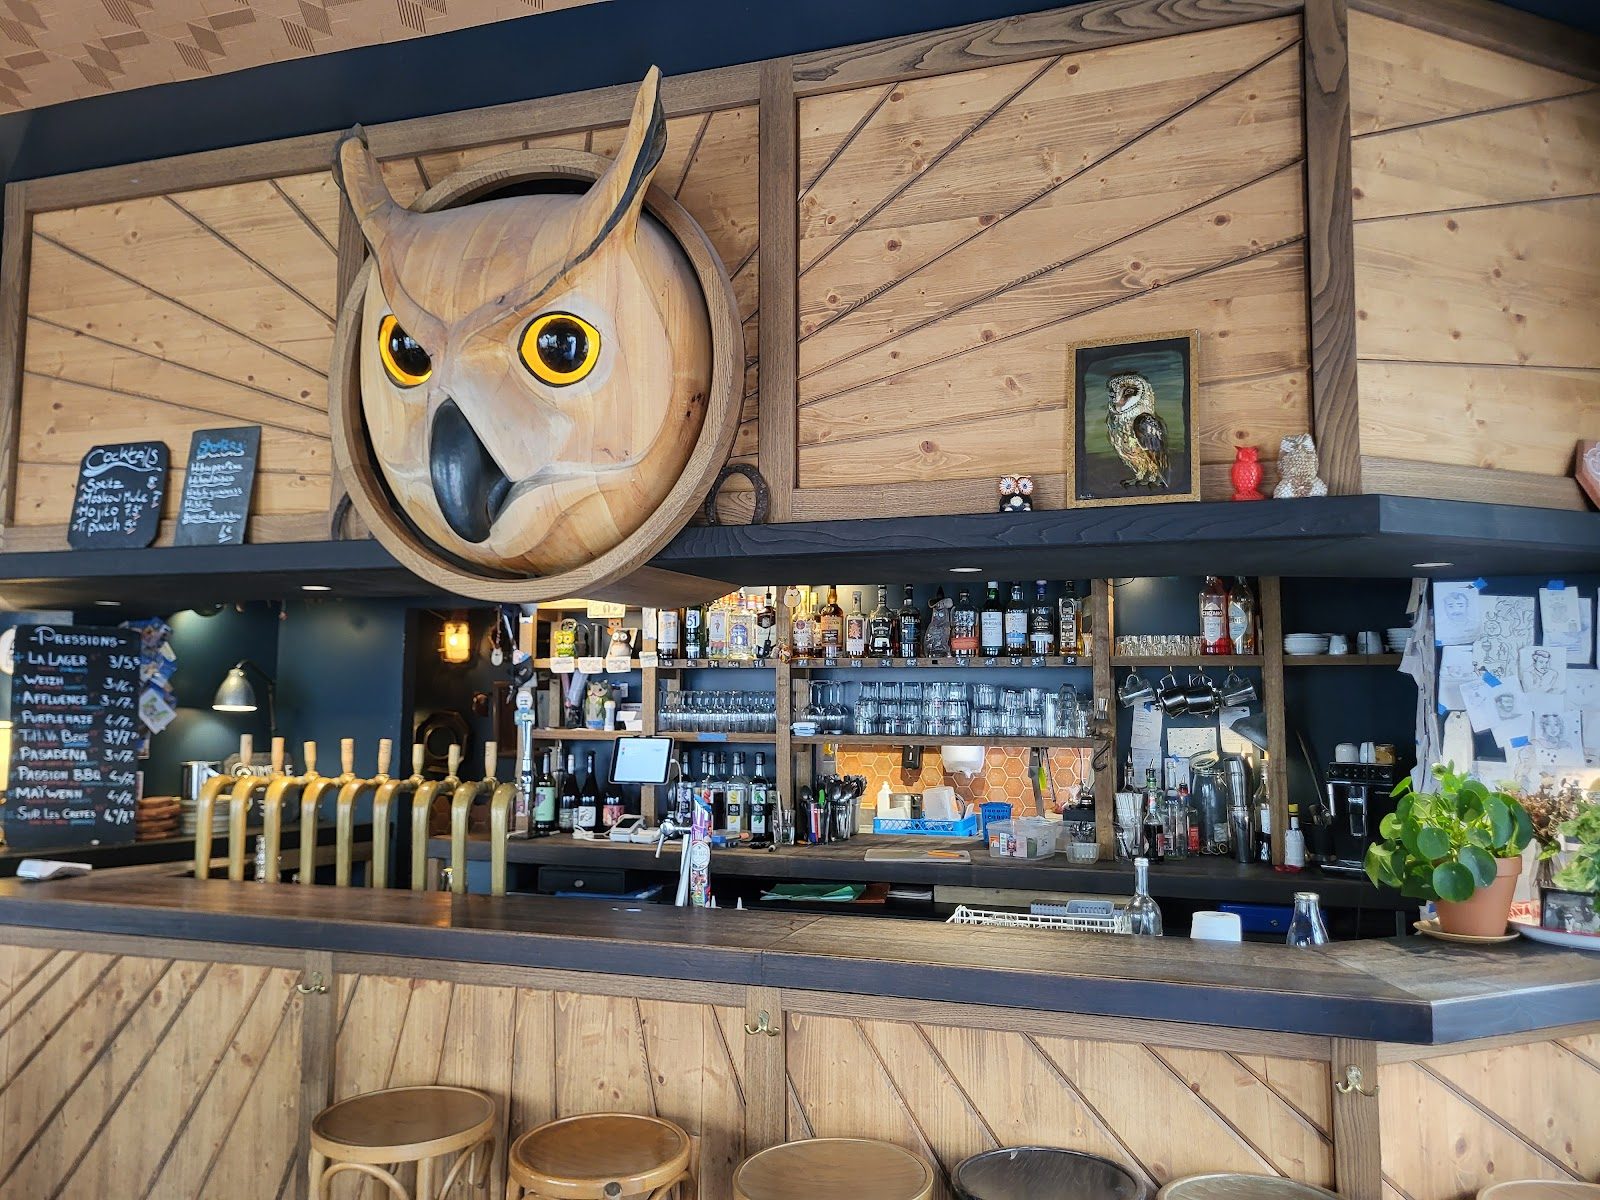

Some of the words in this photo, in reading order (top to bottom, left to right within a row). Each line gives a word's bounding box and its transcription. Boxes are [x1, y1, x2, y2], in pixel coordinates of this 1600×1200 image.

[86, 446, 159, 469] Cocktails
[28, 651, 46, 666] LA
[48, 651, 88, 667] LAGER
[22, 691, 89, 706] AFFLUENCE
[19, 746, 89, 762] PASADENA
[73, 768, 102, 782] BBQ
